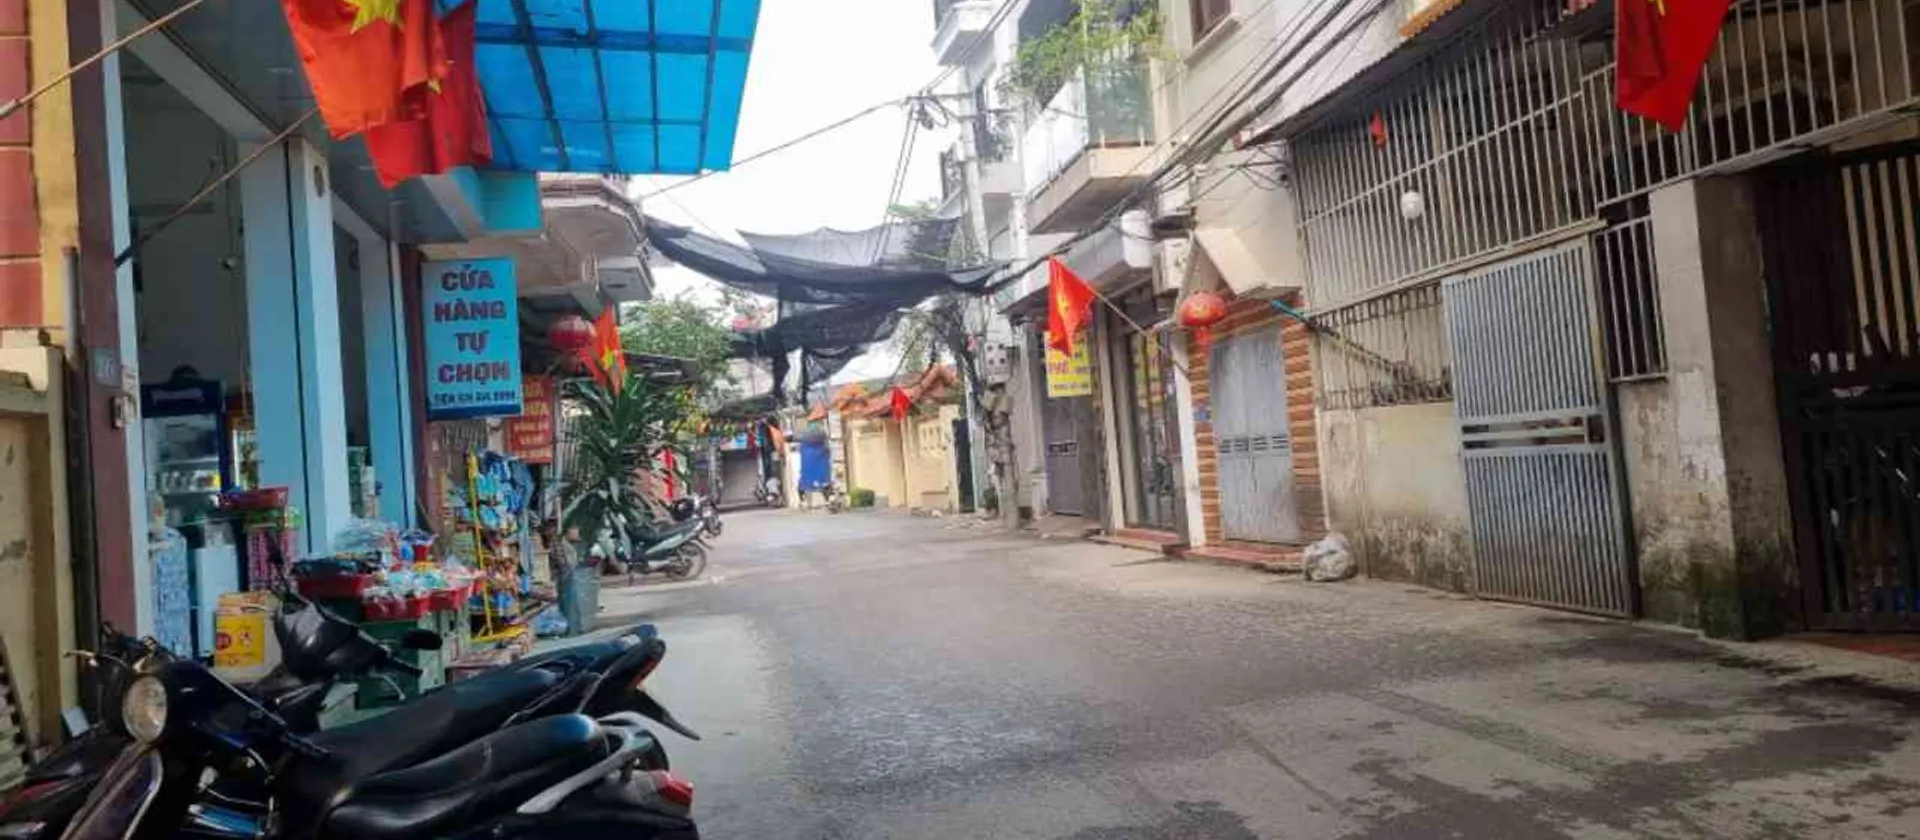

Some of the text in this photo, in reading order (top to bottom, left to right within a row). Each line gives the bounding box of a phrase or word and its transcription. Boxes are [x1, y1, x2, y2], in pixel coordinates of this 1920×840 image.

[442, 264, 495, 291] CỬA
[435, 298, 506, 322] HÀNG
[453, 330, 490, 355] TỰ
[438, 362, 509, 385] CHỌN
